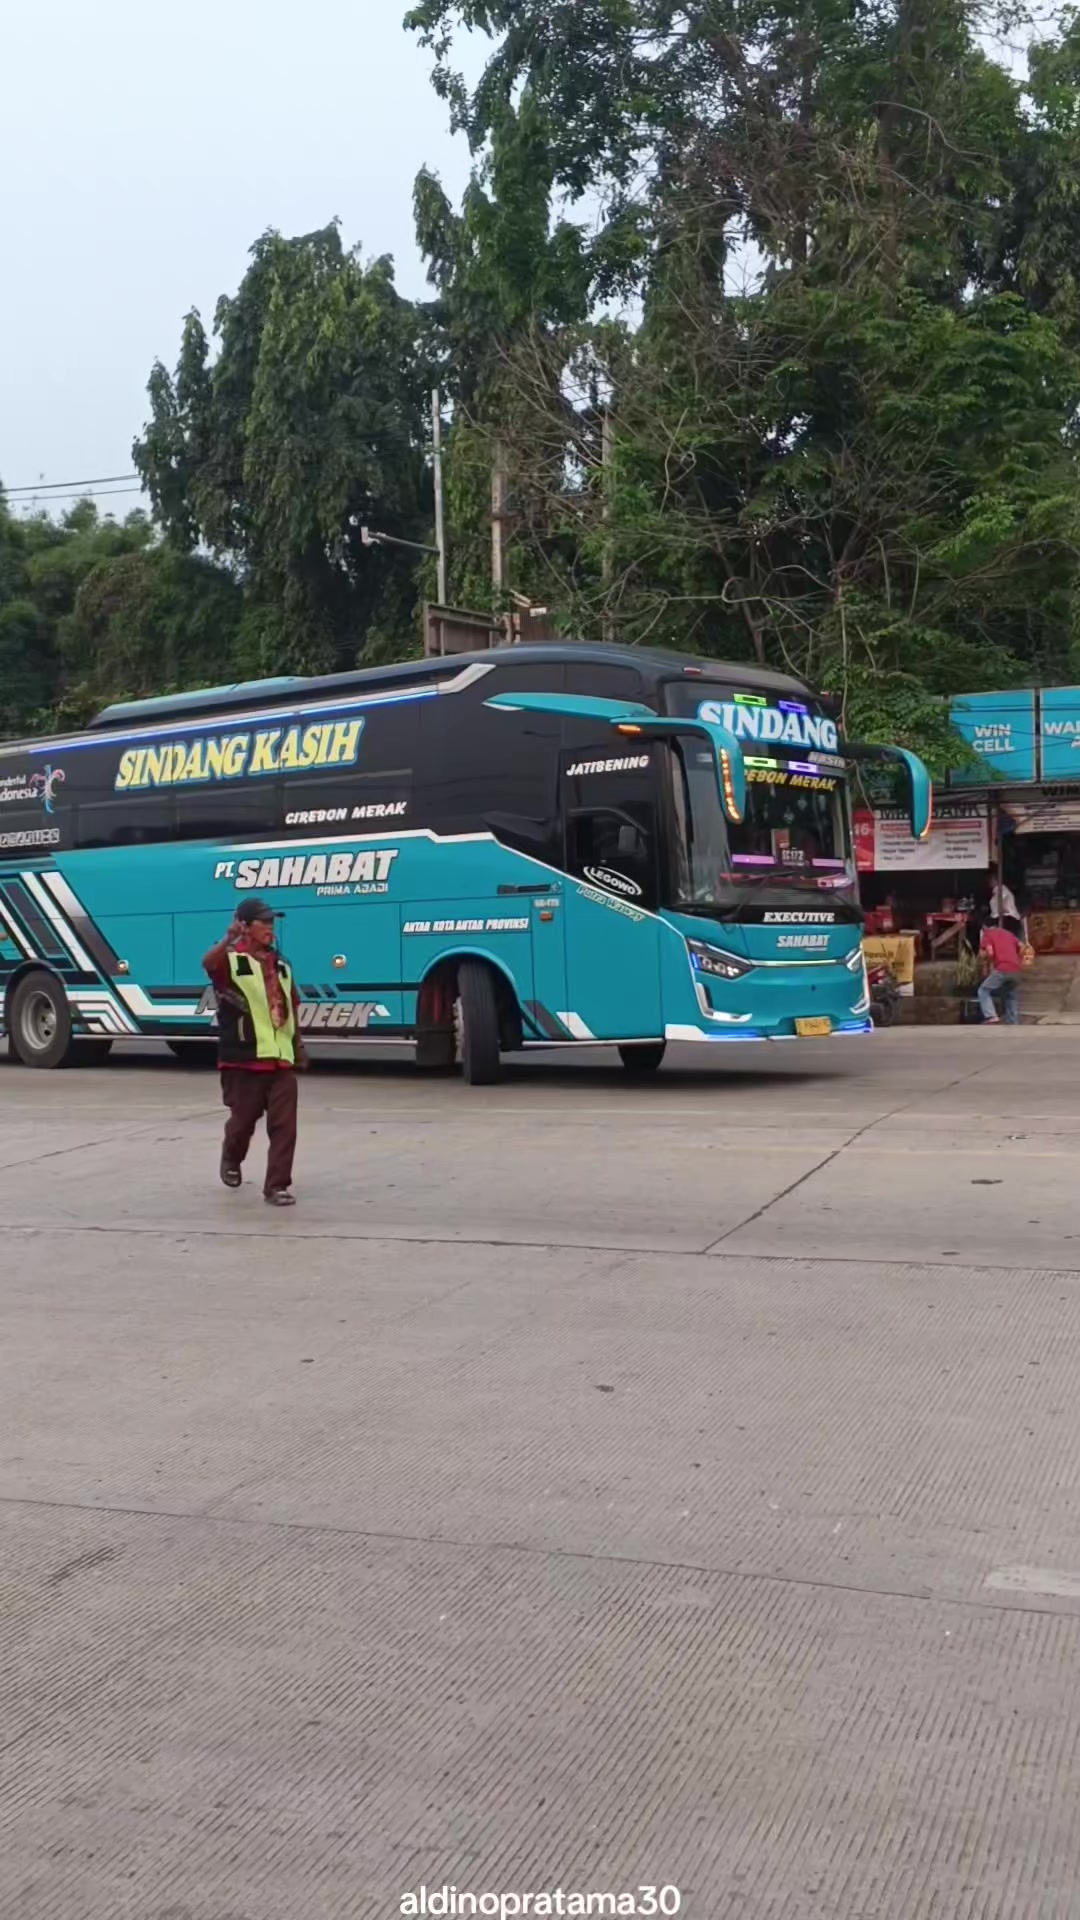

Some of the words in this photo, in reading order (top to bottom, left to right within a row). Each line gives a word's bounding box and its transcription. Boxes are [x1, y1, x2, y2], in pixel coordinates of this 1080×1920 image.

[697, 701, 837, 751] SINDANG
[974, 723, 1012, 737] WIN
[114, 733, 248, 790] SINDANG
[248, 716, 365, 774] KASIH
[972, 739, 1016, 752] CELL
[566, 754, 650, 776] JATIBENING
[789, 773, 836, 792] MERAK
[285, 806, 348, 825] CIREBON
[351, 800, 407, 820] MERAK
[235, 849, 400, 889] SAHABAT
[590, 866, 636, 896] LEGOWO
[316, 885, 351, 897] PRIMA
[454, 919, 485, 931] ANTAR
[486, 917, 530, 930] PROVINSI
[763, 911, 835, 923] EXECUTIVE
[776, 934, 831, 948] SAHABAT
